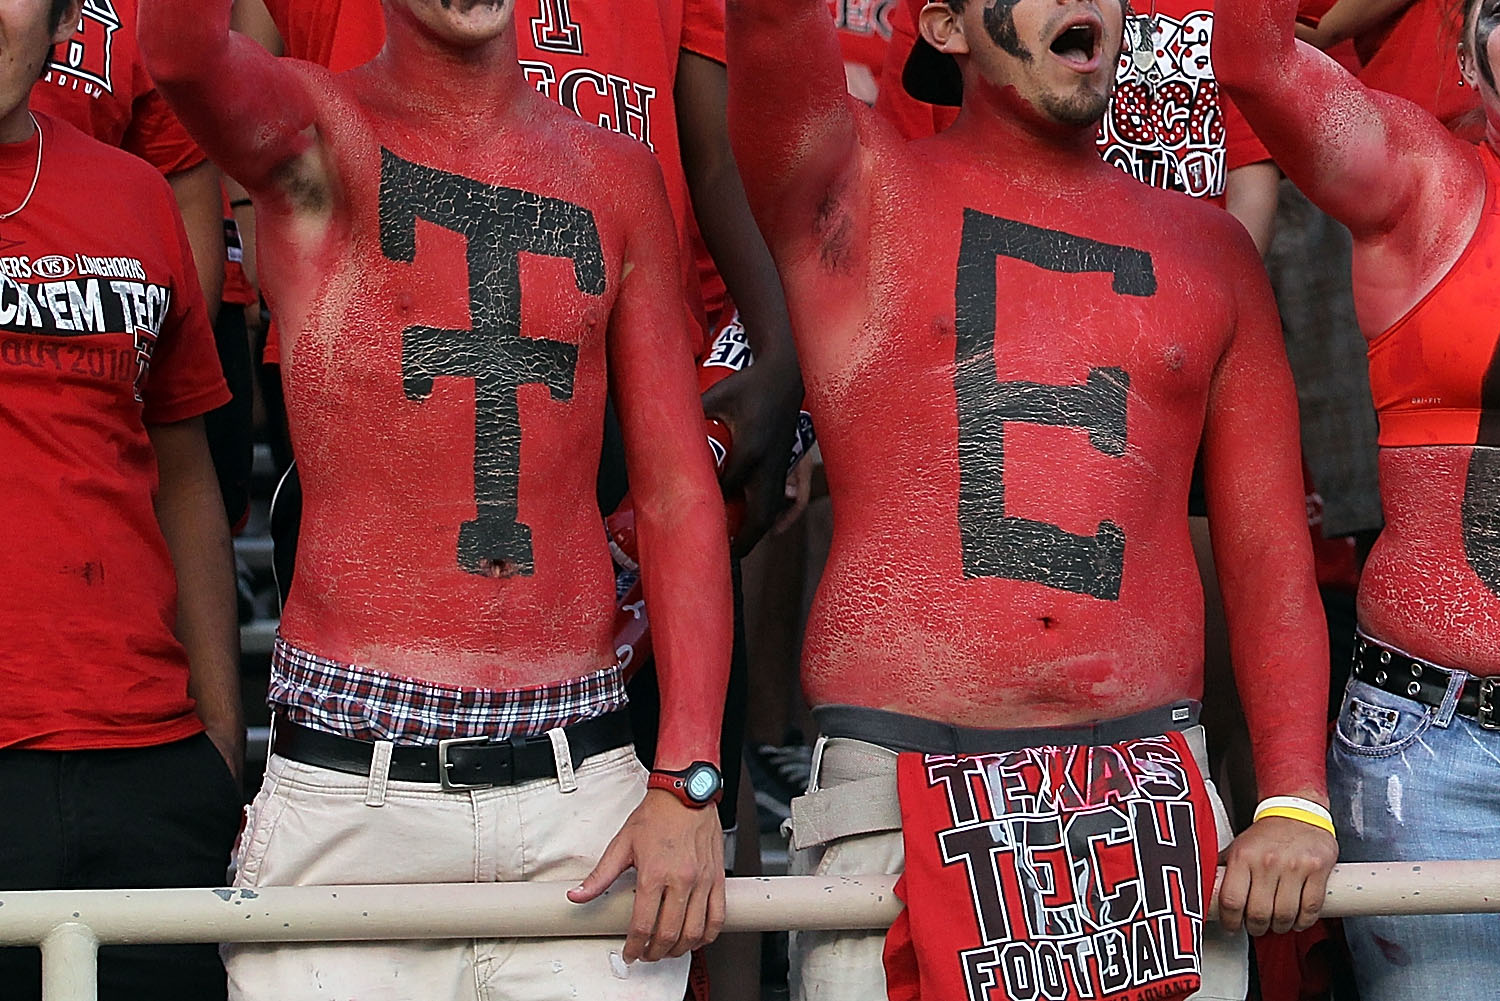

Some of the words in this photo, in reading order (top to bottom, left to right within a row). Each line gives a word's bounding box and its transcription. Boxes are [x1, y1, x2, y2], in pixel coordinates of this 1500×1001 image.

[45, 258, 62, 273] VS
[75, 253, 147, 282] LONGHORNS
[955, 207, 1155, 600] E
[926, 740, 1191, 828] TEXAS
[938, 799, 1203, 945] TECH
